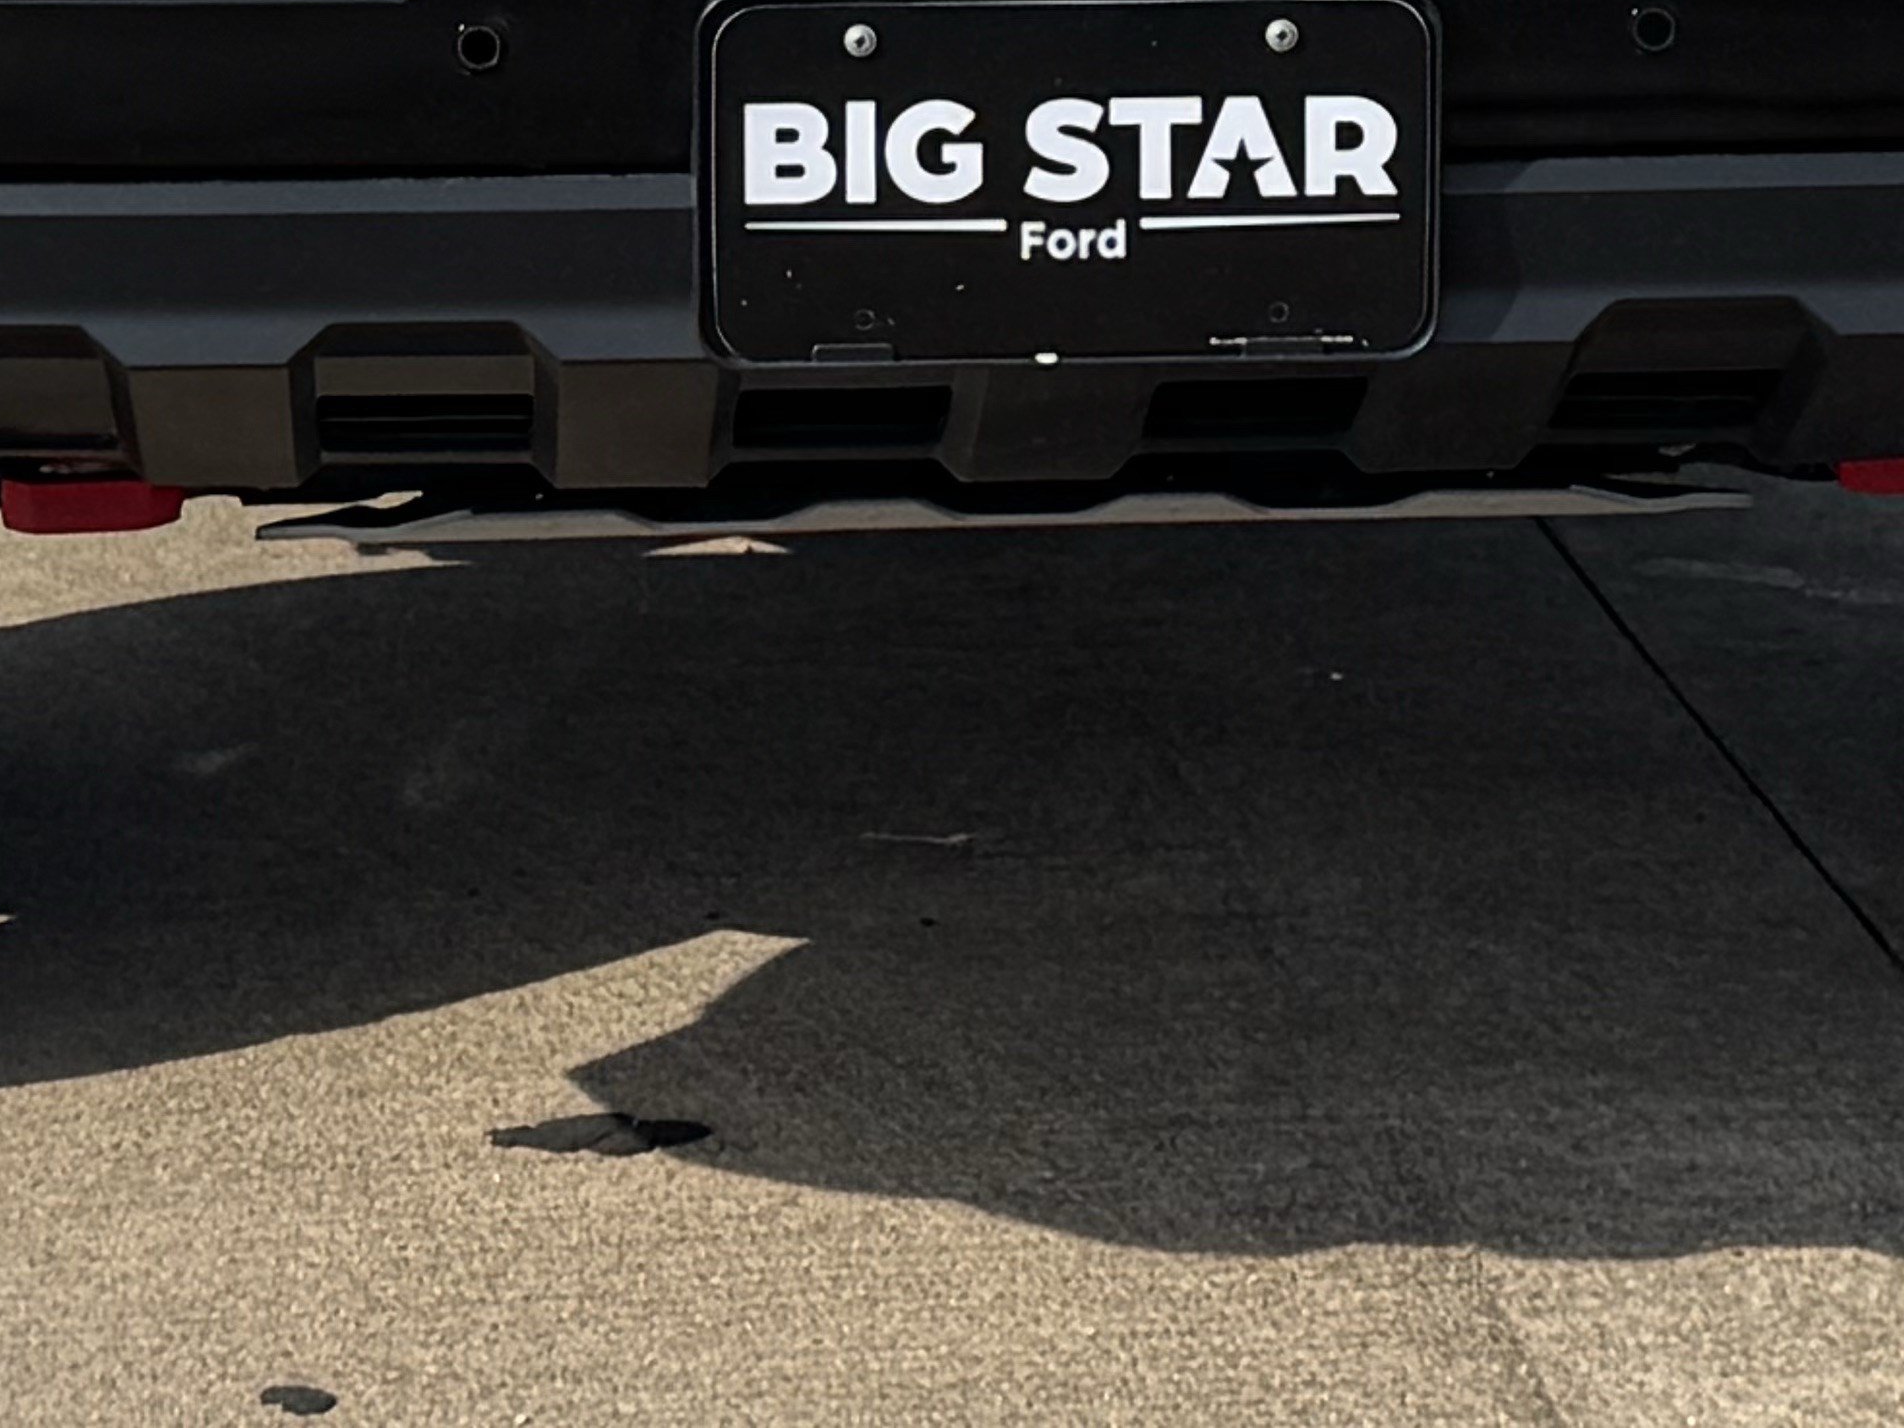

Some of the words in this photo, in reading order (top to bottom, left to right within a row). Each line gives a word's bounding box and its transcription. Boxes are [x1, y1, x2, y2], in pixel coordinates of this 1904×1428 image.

[742, 98, 985, 206] BIG
[1022, 94, 1399, 204] STAR
[1018, 217, 1128, 261] Ford
